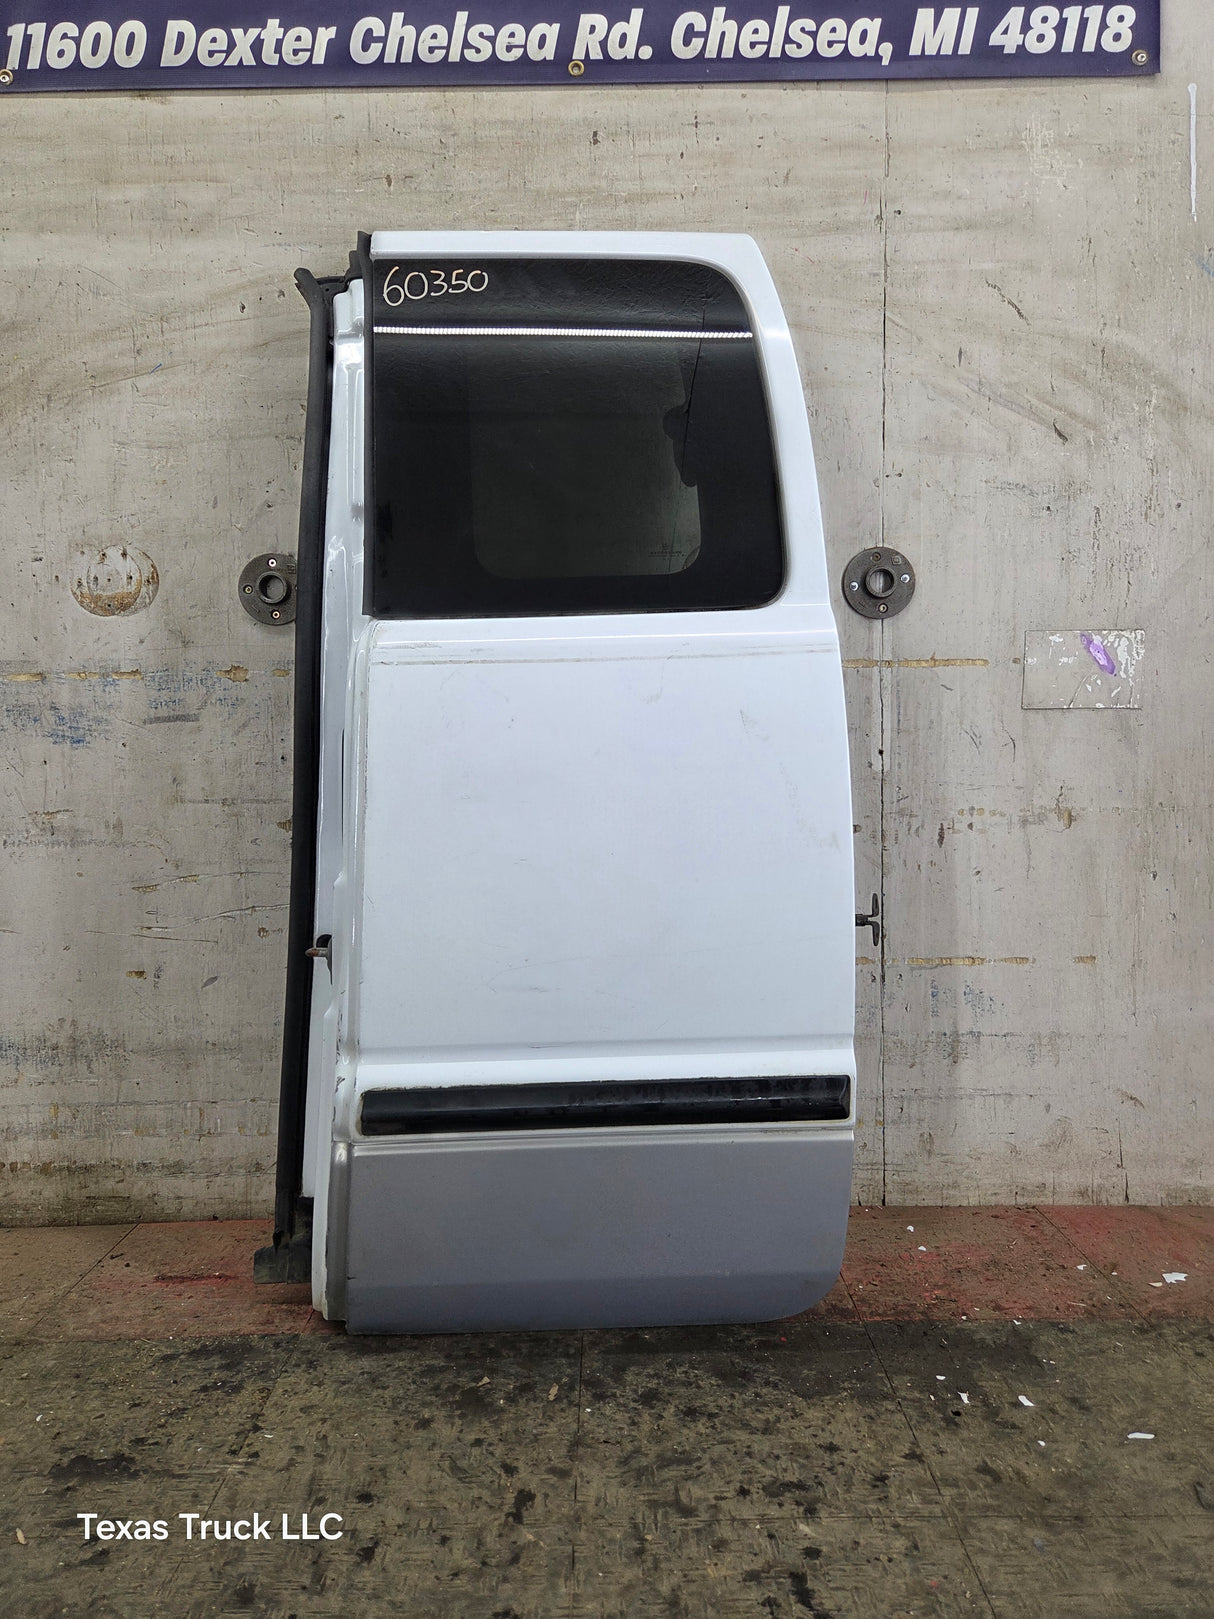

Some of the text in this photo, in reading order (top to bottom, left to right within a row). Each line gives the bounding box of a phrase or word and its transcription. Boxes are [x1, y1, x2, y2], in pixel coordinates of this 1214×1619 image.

[6, 4, 1136, 70] 11600 Dexter Chelsea Rd. Chelsea, MI 48118
[383, 266, 488, 306] 60350
